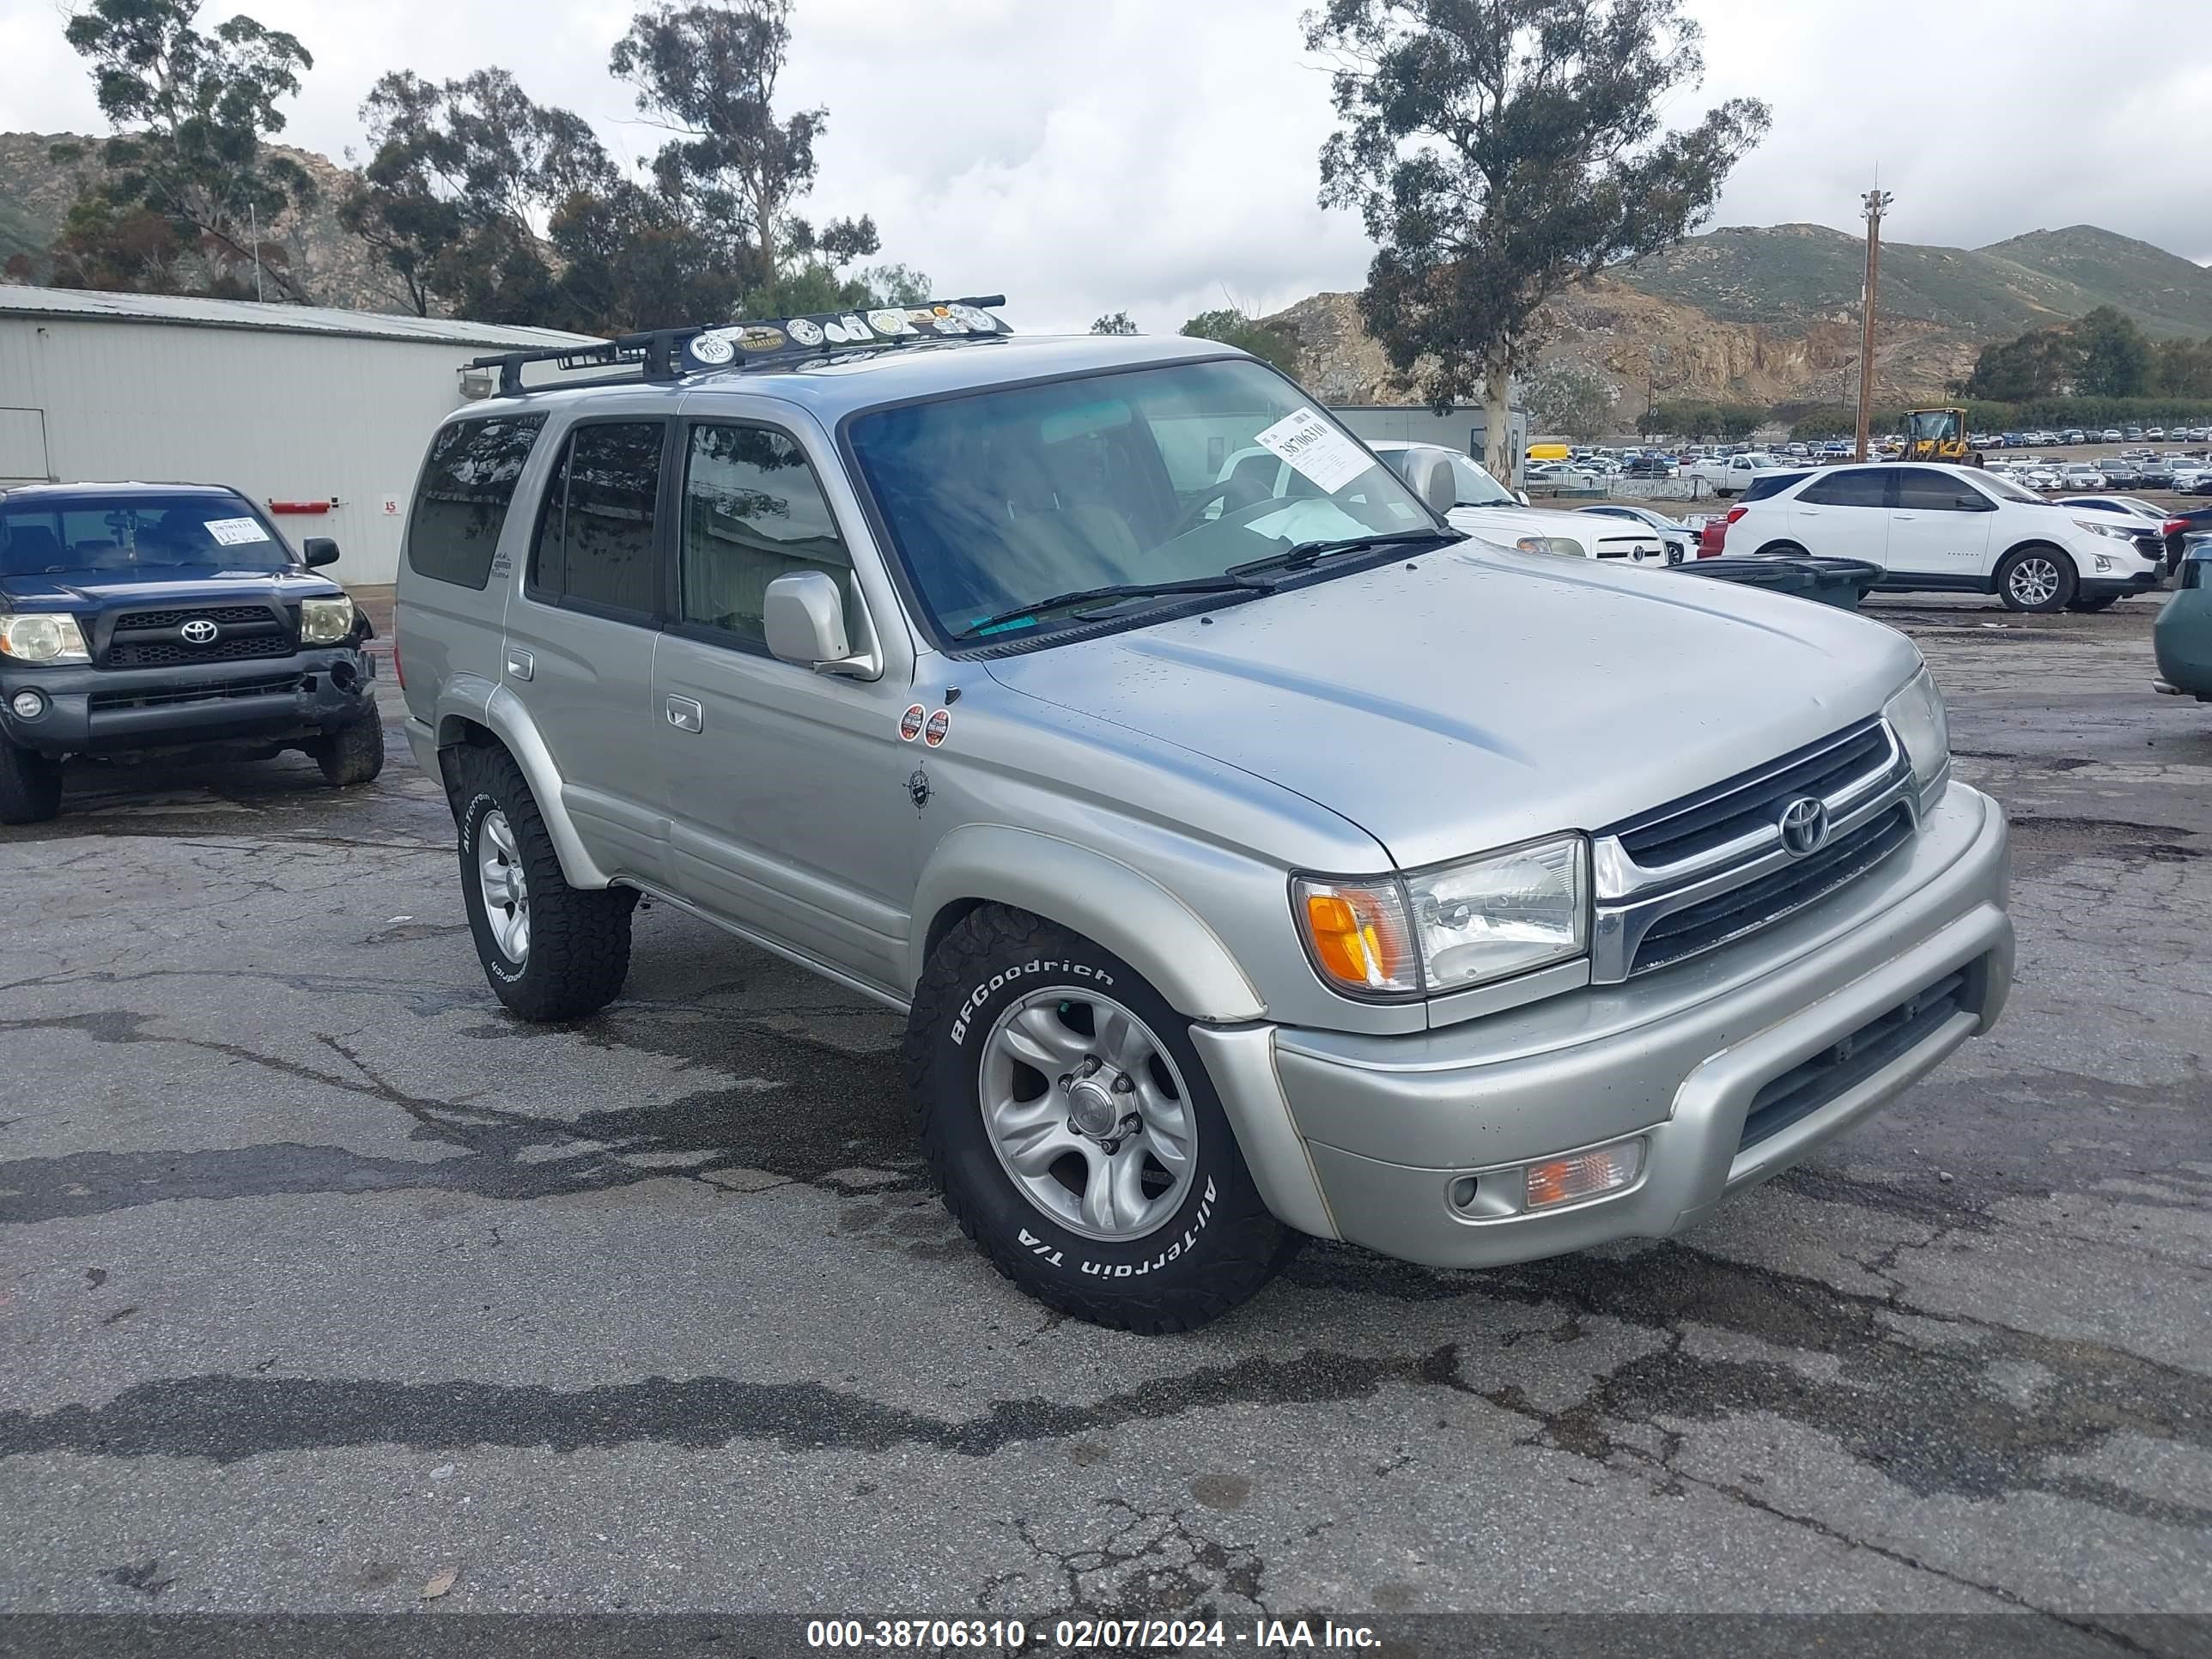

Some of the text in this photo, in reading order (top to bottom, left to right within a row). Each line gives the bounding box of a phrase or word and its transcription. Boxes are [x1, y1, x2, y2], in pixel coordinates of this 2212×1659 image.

[742, 337, 782, 349] YOTATECH
[1279, 422, 1328, 457] 38706310
[385, 501, 396, 510] 15
[950, 958, 1115, 1046] BFGoodrich
[1016, 1175, 1218, 1280] All-Terrain T/A
